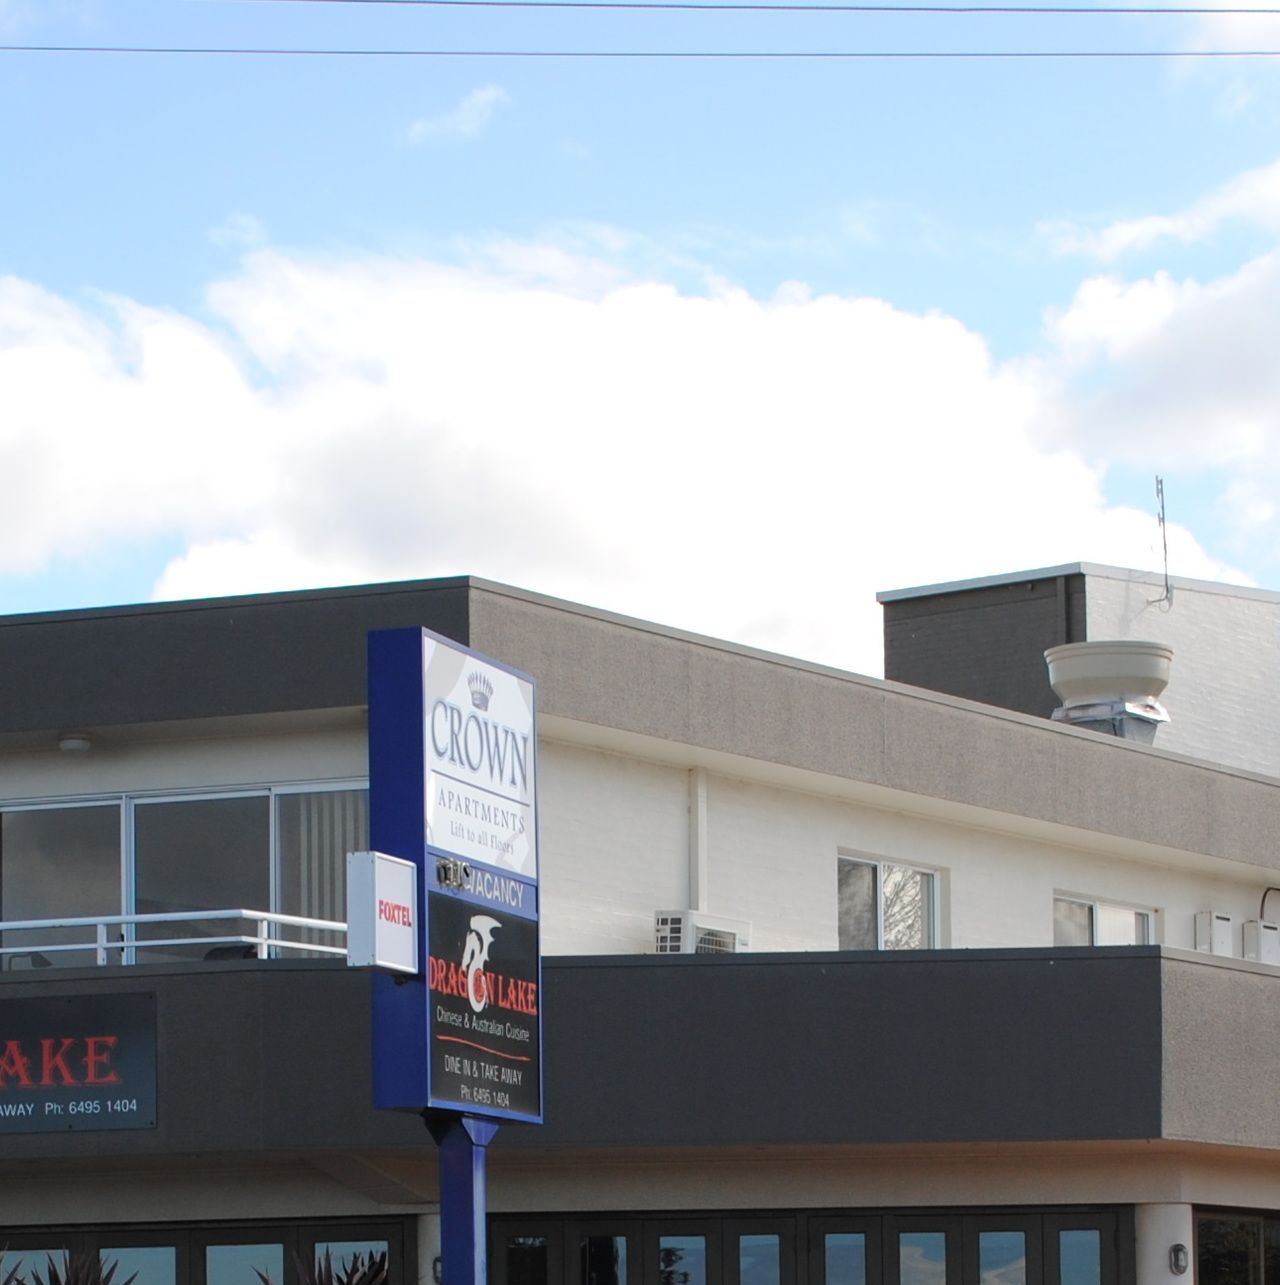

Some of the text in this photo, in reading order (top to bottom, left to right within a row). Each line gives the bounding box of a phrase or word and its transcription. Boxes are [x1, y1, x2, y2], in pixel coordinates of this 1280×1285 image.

[431, 700, 529, 792] CROWN
[438, 786, 526, 834] APARTMENTS
[450, 820, 465, 840] Lift
[466, 827, 475, 843] to
[477, 831, 489, 848] all
[467, 870, 524, 908] VACANCY
[378, 899, 412, 927] FOXTEL
[428, 956, 538, 1016] DRAGON LAKE
[436, 1005, 530, 1043] Chinese & Australian Cuisine
[444, 1054, 522, 1086] DINE IN & TAKE AWAY
[68, 1100, 101, 1115] 6495
[106, 1098, 137, 1113] 1404
[493, 1090, 510, 1107] 1404
